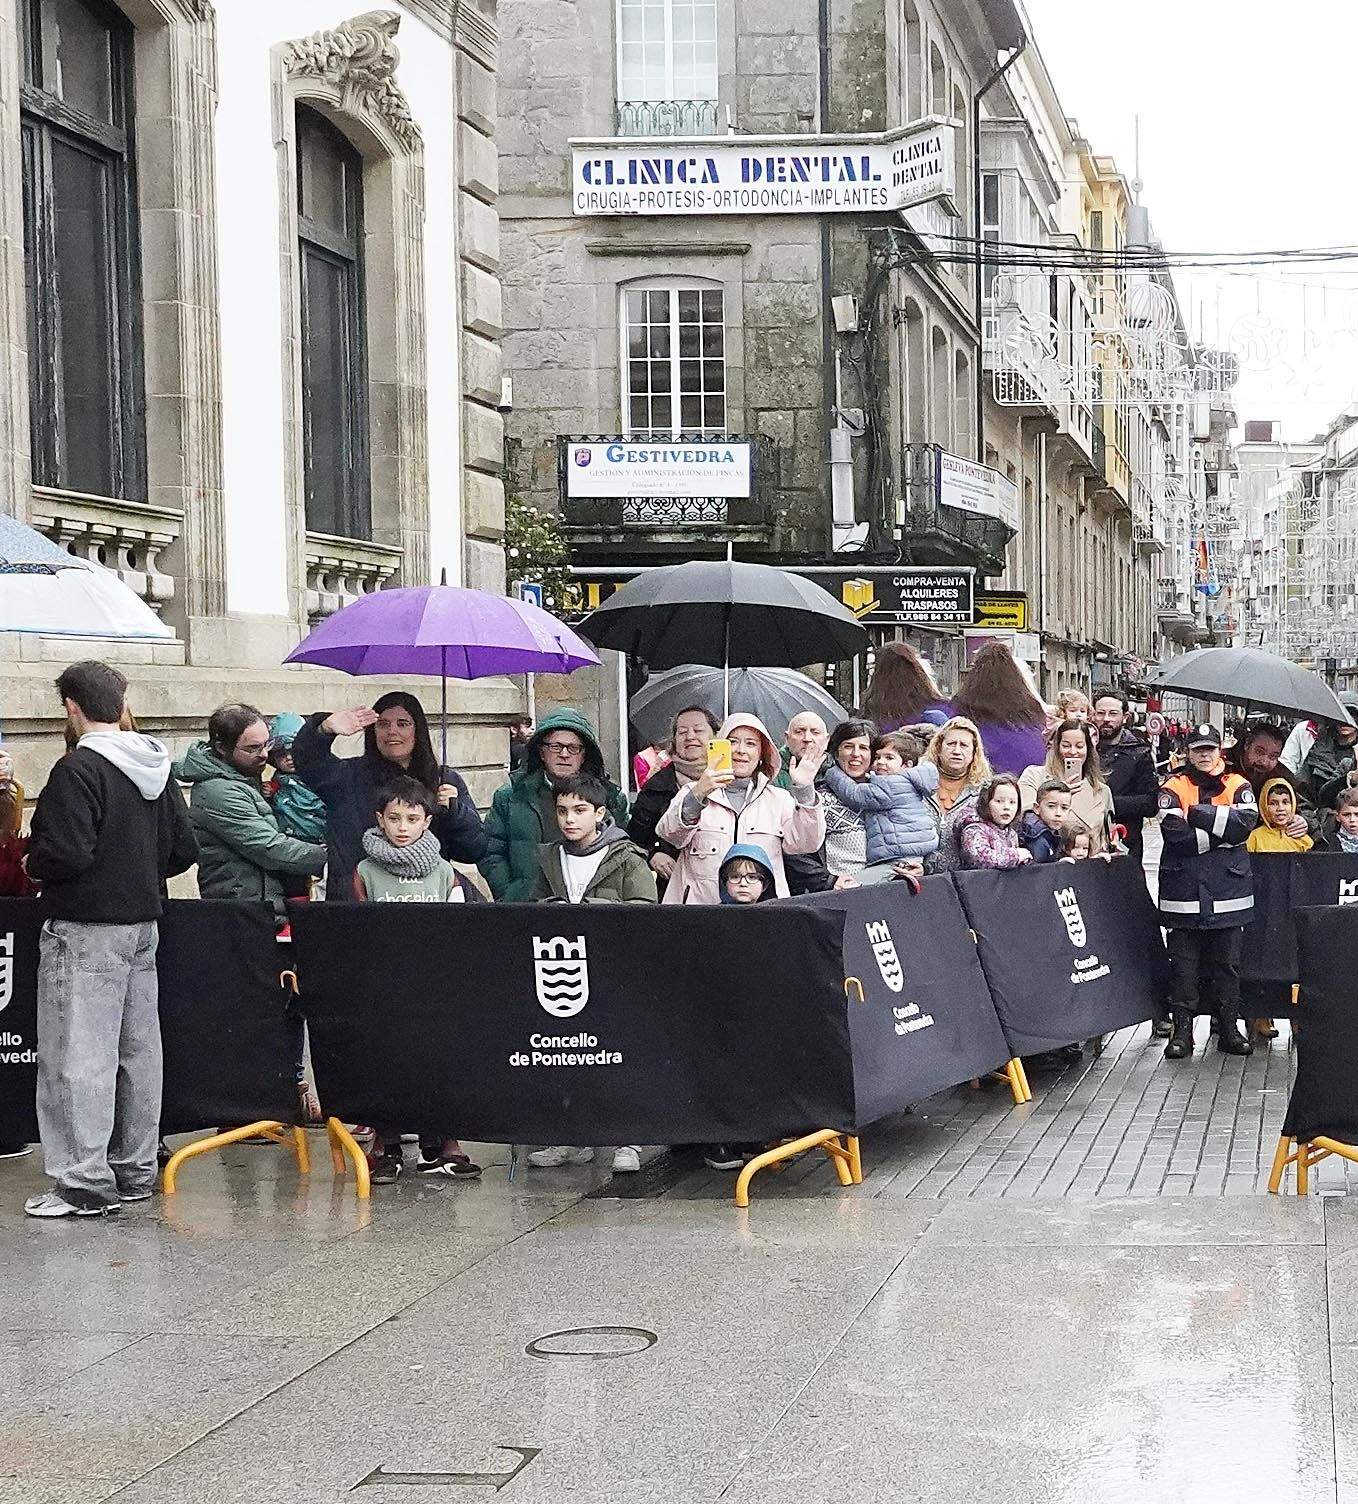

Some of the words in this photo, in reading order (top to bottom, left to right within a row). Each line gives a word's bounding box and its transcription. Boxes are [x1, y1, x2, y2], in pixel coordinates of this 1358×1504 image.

[893, 137, 941, 166] CLINICA
[582, 157, 720, 186] CLINICA
[741, 155, 882, 184] DENTAL
[893, 159, 943, 187] DENTAL
[606, 444, 735, 463] GESTIVEDRA
[893, 576, 966, 587] COMPRA-VENTA
[900, 588, 959, 599] ALQUILERES
[901, 600, 958, 611] TRASPASOS
[0, 1031, 22, 1046] llo
[530, 1033, 599, 1049] Concello
[509, 1051, 529, 1067] de
[532, 1049, 623, 1067] Pontevedra
